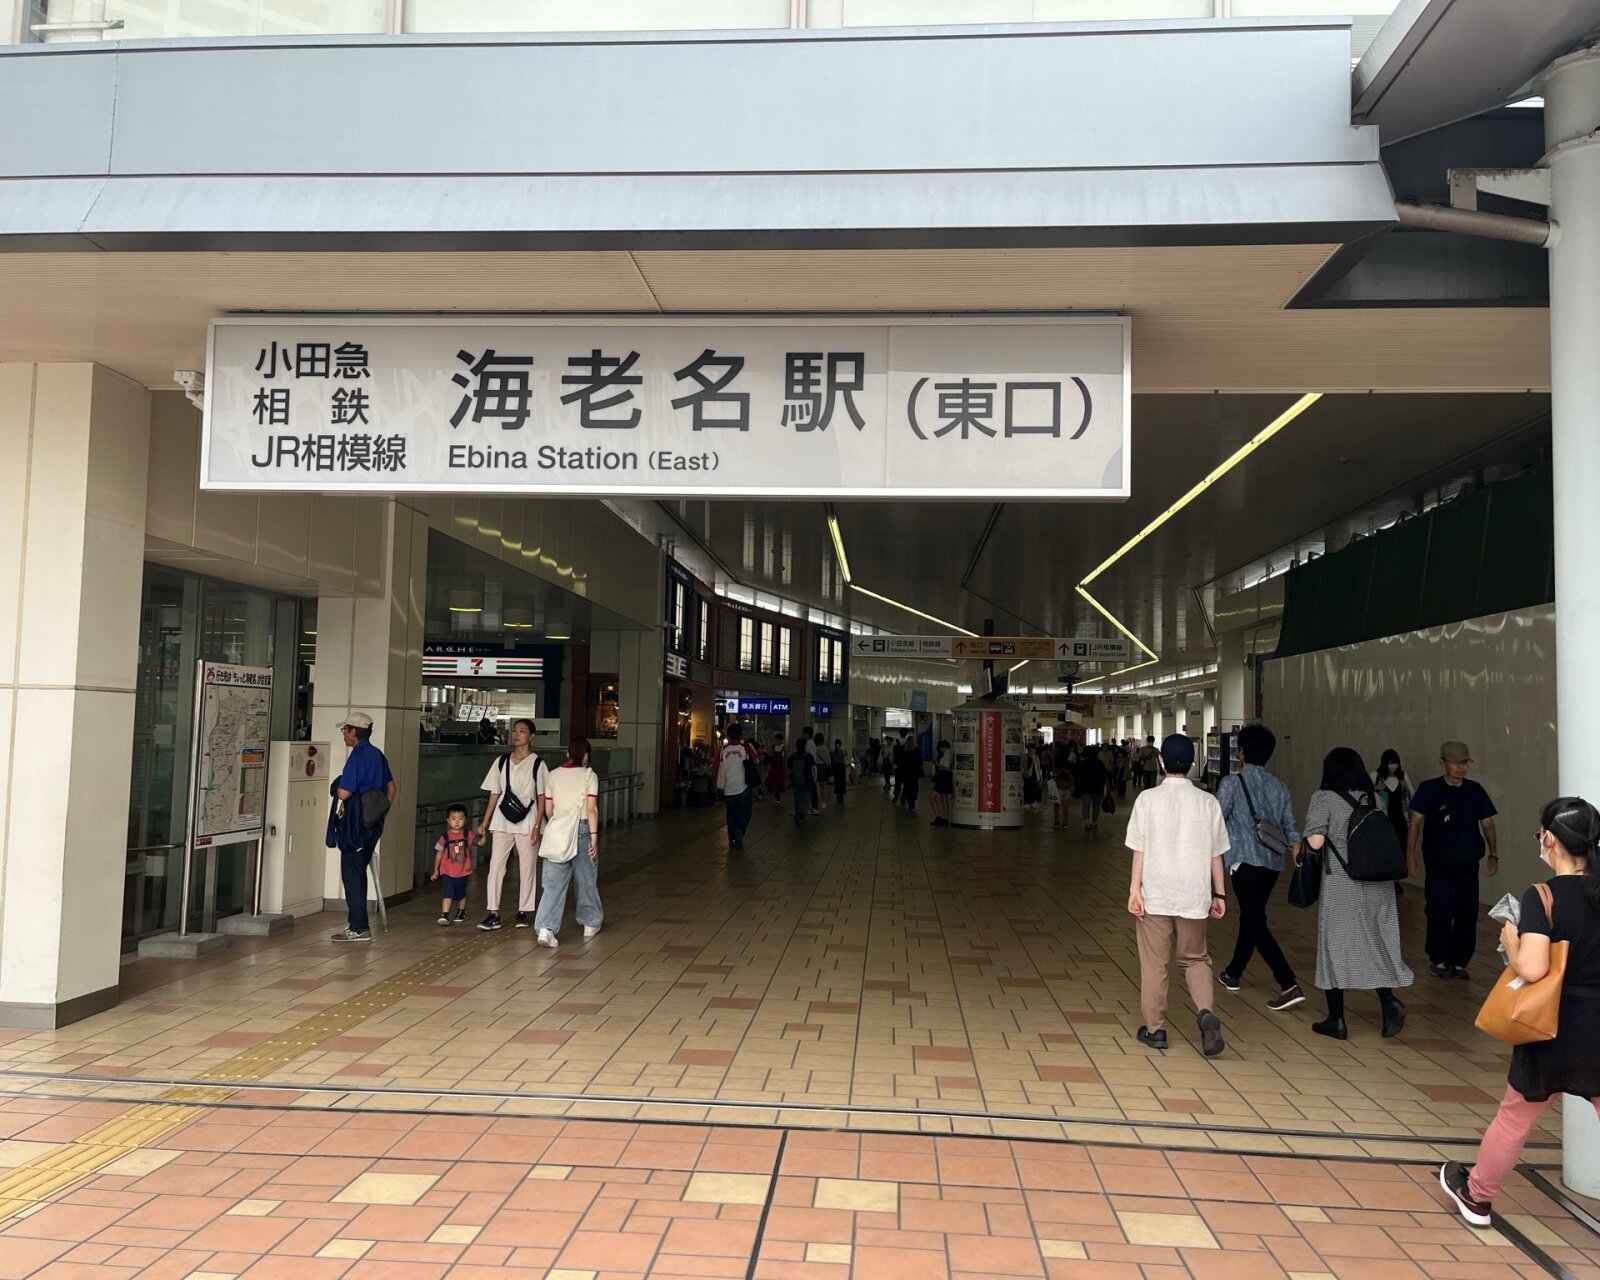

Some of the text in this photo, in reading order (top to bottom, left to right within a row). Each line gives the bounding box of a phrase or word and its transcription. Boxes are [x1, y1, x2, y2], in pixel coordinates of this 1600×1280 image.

[255, 341, 371, 380] 小田急
[252, 387, 370, 425] 相鉄
[449, 348, 1092, 440] 海老名駅 (東口)
[252, 433, 407, 472] JR相模線
[449, 445, 719, 471] Ebina Station (East)
[741, 703, 768, 711] 横浜銀行
